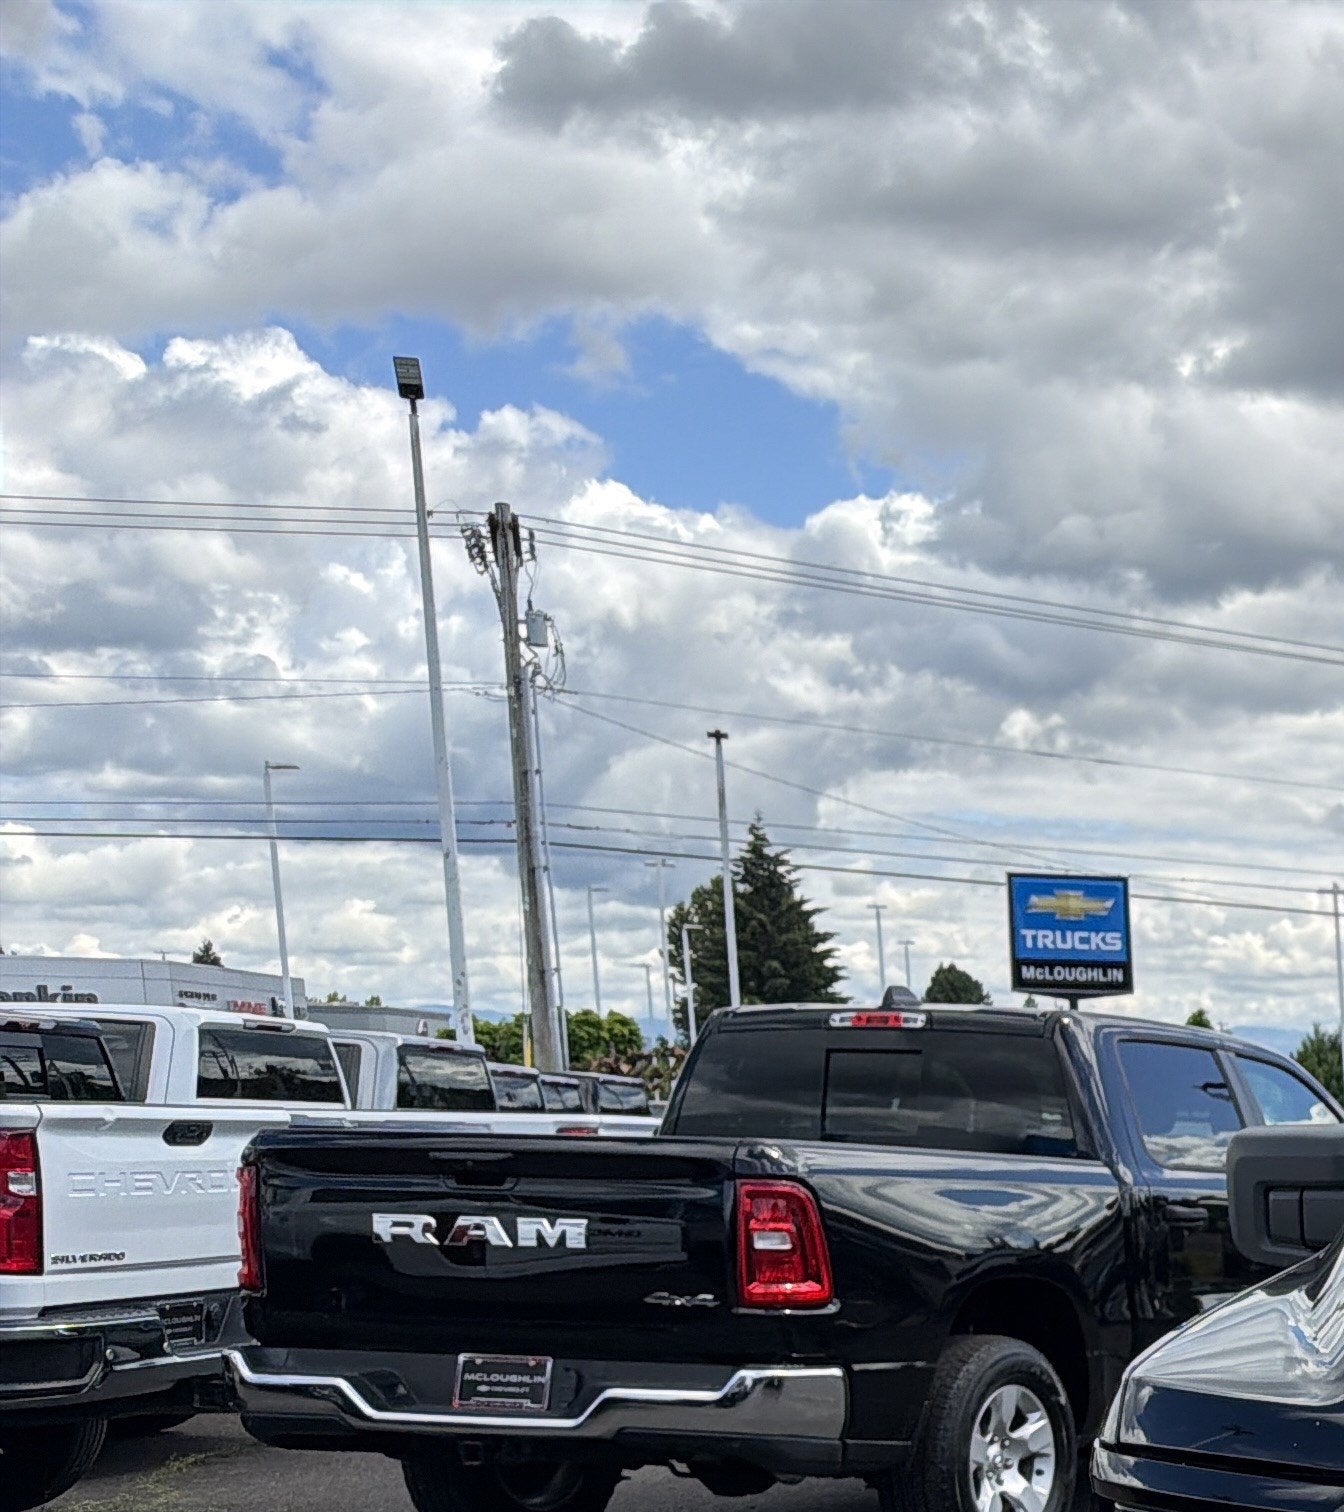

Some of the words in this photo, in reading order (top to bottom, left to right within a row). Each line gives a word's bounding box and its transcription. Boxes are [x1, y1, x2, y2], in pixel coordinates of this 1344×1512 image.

[1020, 929, 1122, 951] TRUCKS
[1021, 965, 1124, 983] McLOUGHLIN
[68, 1171, 240, 1197] CHEVRO
[371, 1212, 589, 1249] RAM
[463, 1372, 547, 1384] MCLOUGHLIN
